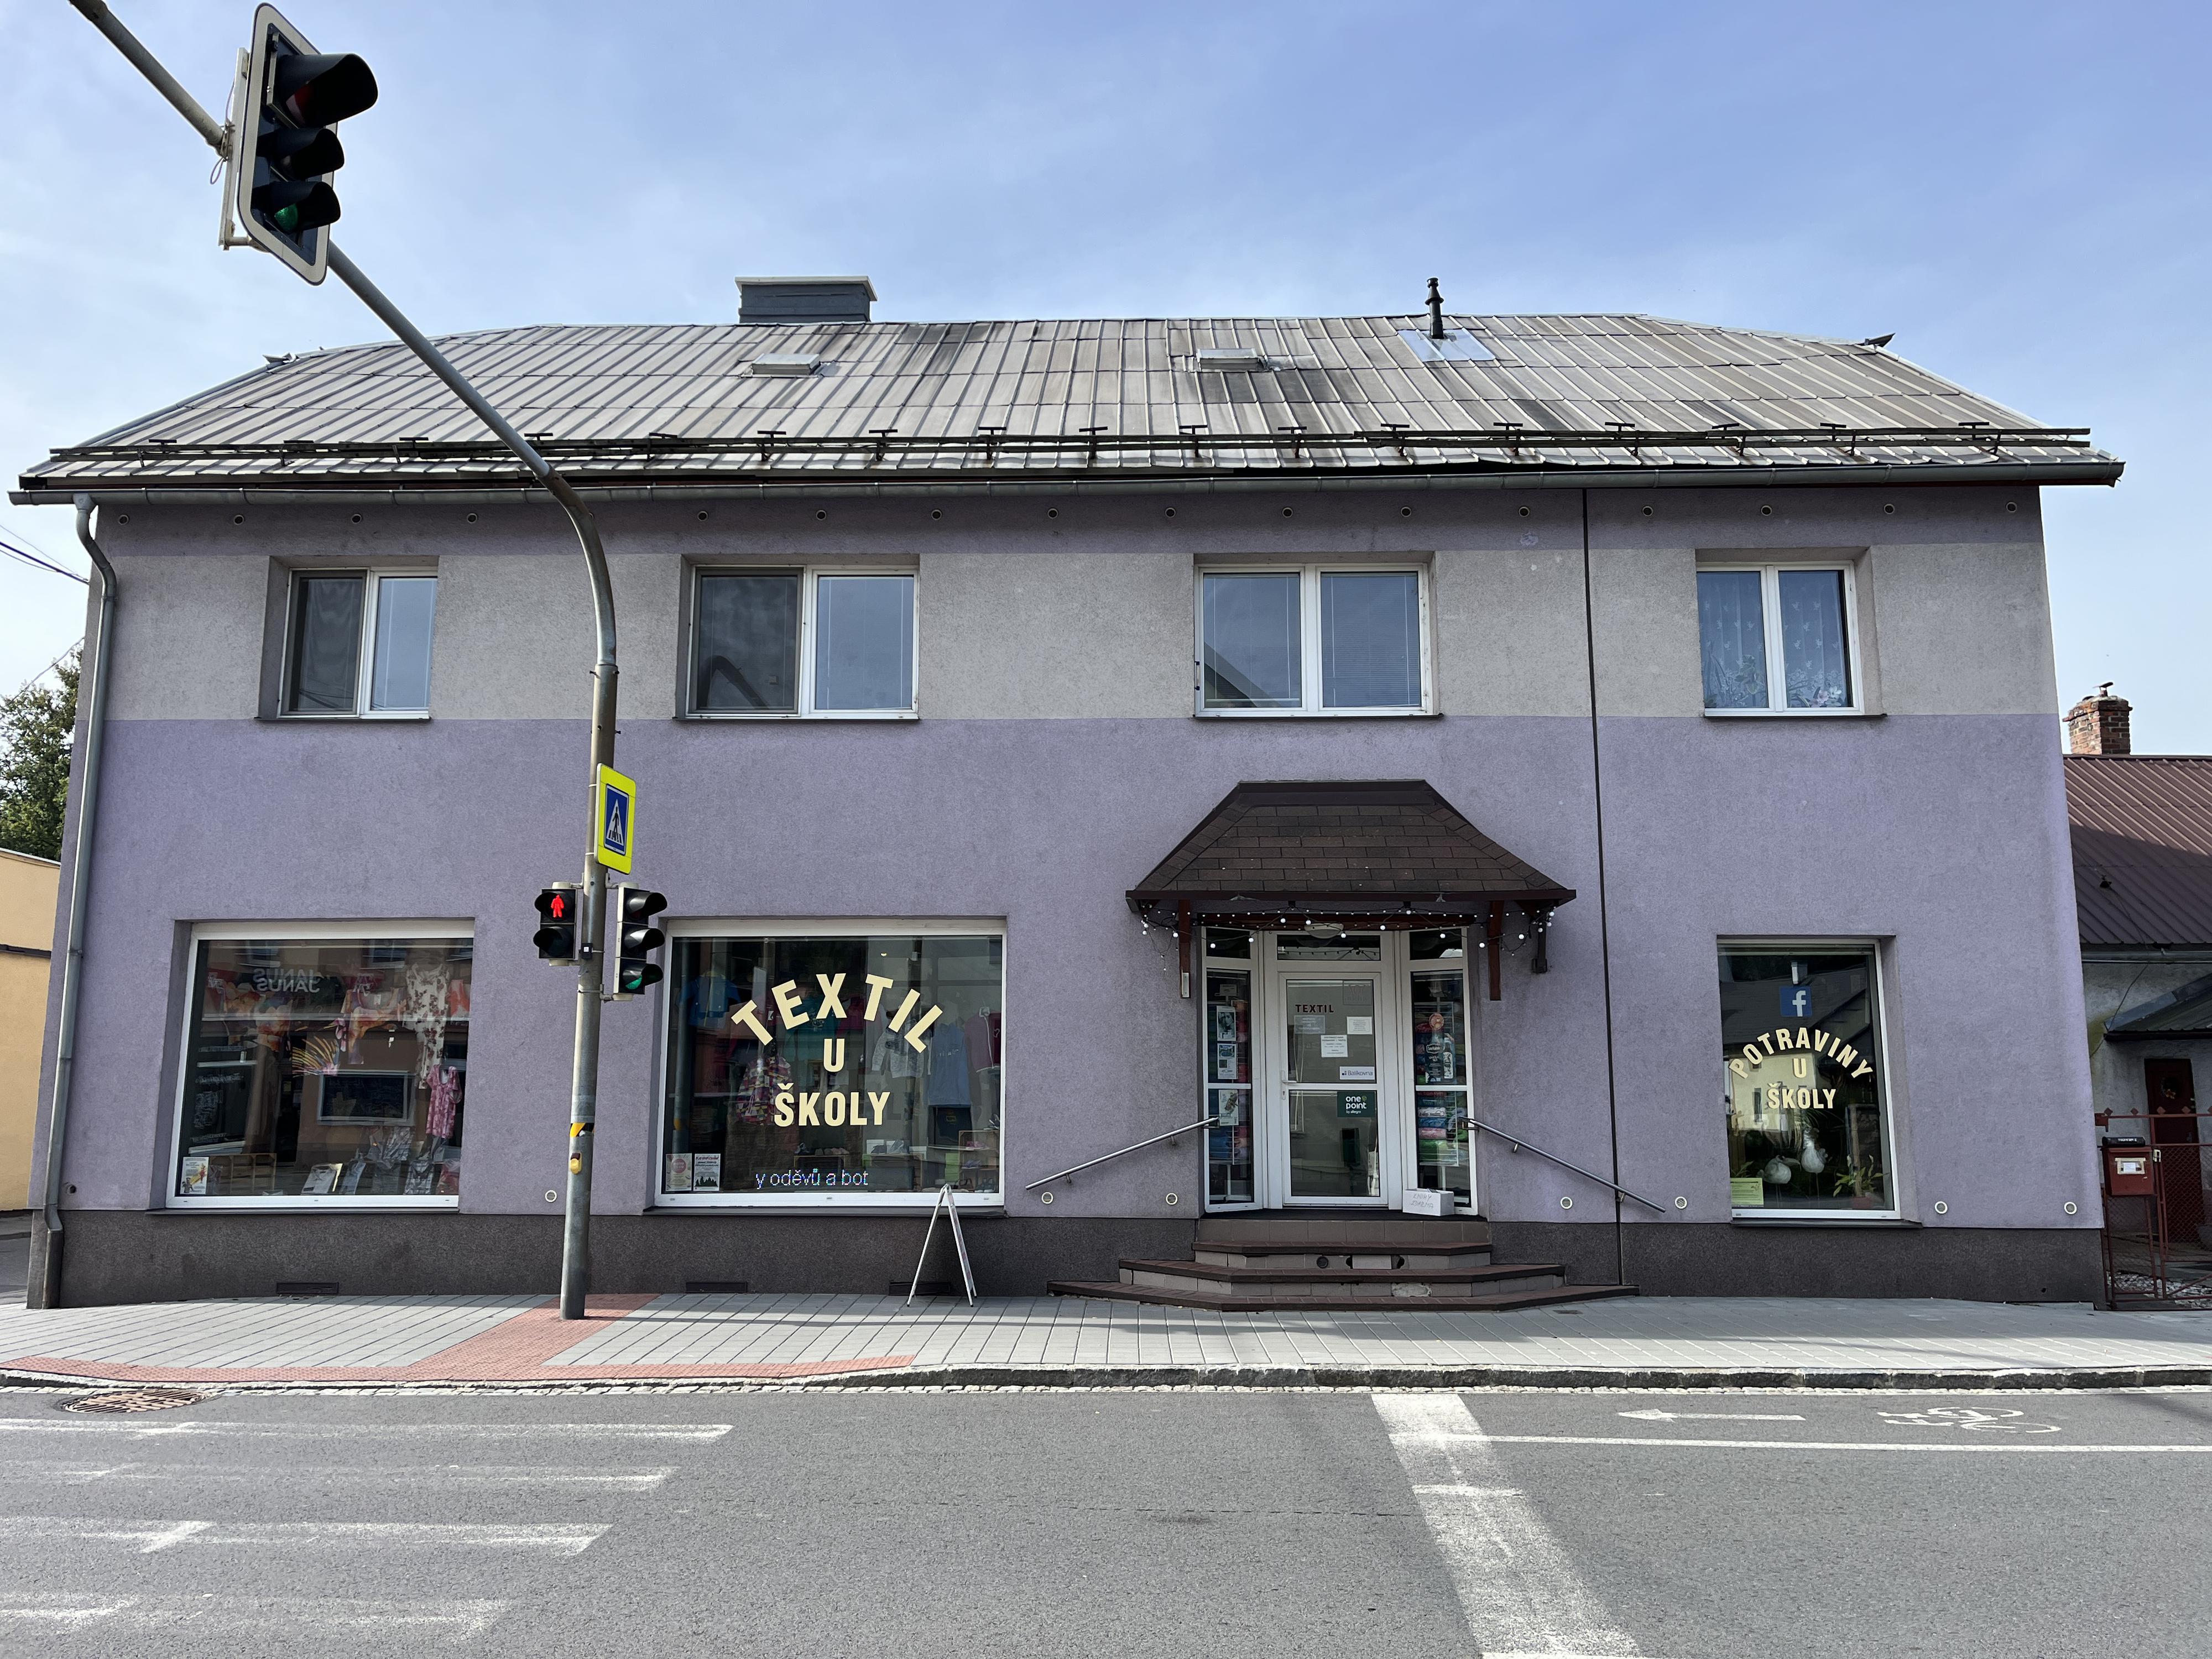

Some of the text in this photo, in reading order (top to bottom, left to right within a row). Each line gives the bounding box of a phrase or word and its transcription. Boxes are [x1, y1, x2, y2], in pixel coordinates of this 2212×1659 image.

[731, 973, 943, 1053] TEXTIL
[1295, 1004, 1334, 1013] TEXTIL
[824, 1039, 845, 1072] U
[1729, 1027, 1873, 1079] POTRAVINY
[1793, 1057, 1807, 1078] U
[774, 1082, 890, 1127] ŠKOLY
[1767, 1082, 1837, 1109] ŠKOLY
[770, 1168, 820, 1186] oděvů
[826, 1173, 836, 1186] a
[841, 1169, 869, 1186] bot
